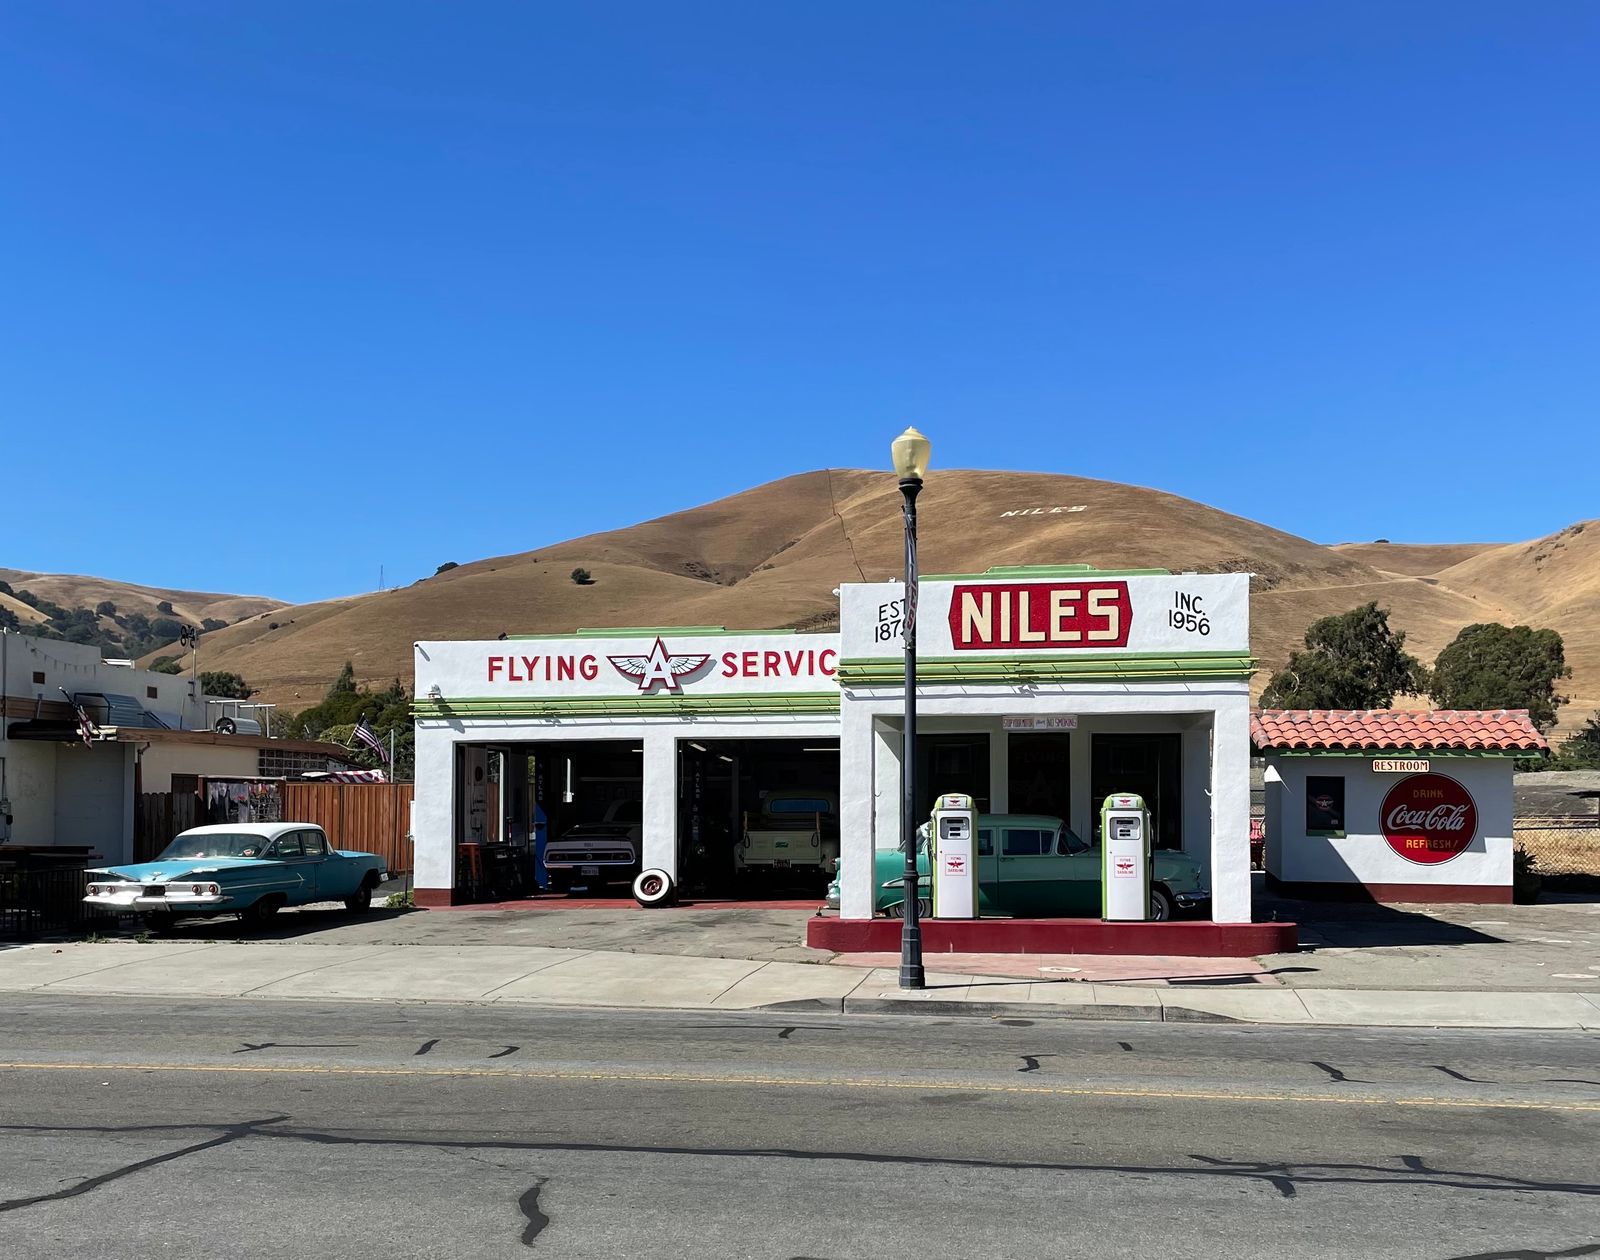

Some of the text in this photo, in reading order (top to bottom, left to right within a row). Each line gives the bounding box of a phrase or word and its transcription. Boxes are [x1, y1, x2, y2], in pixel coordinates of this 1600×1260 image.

[1000, 505, 1088, 518] NILES
[961, 589, 1119, 643] NILES
[1175, 591, 1206, 616] INC.
[1169, 609, 1210, 636] 1956
[488, 654, 599, 682] FLYING
[721, 649, 837, 678] SERVIC
[1374, 761, 1428, 771] RESTROOM
[1413, 789, 1444, 799] DRINK
[1386, 804, 1471, 831] Coca-Cola
[1406, 839, 1458, 851] REFRESH!
